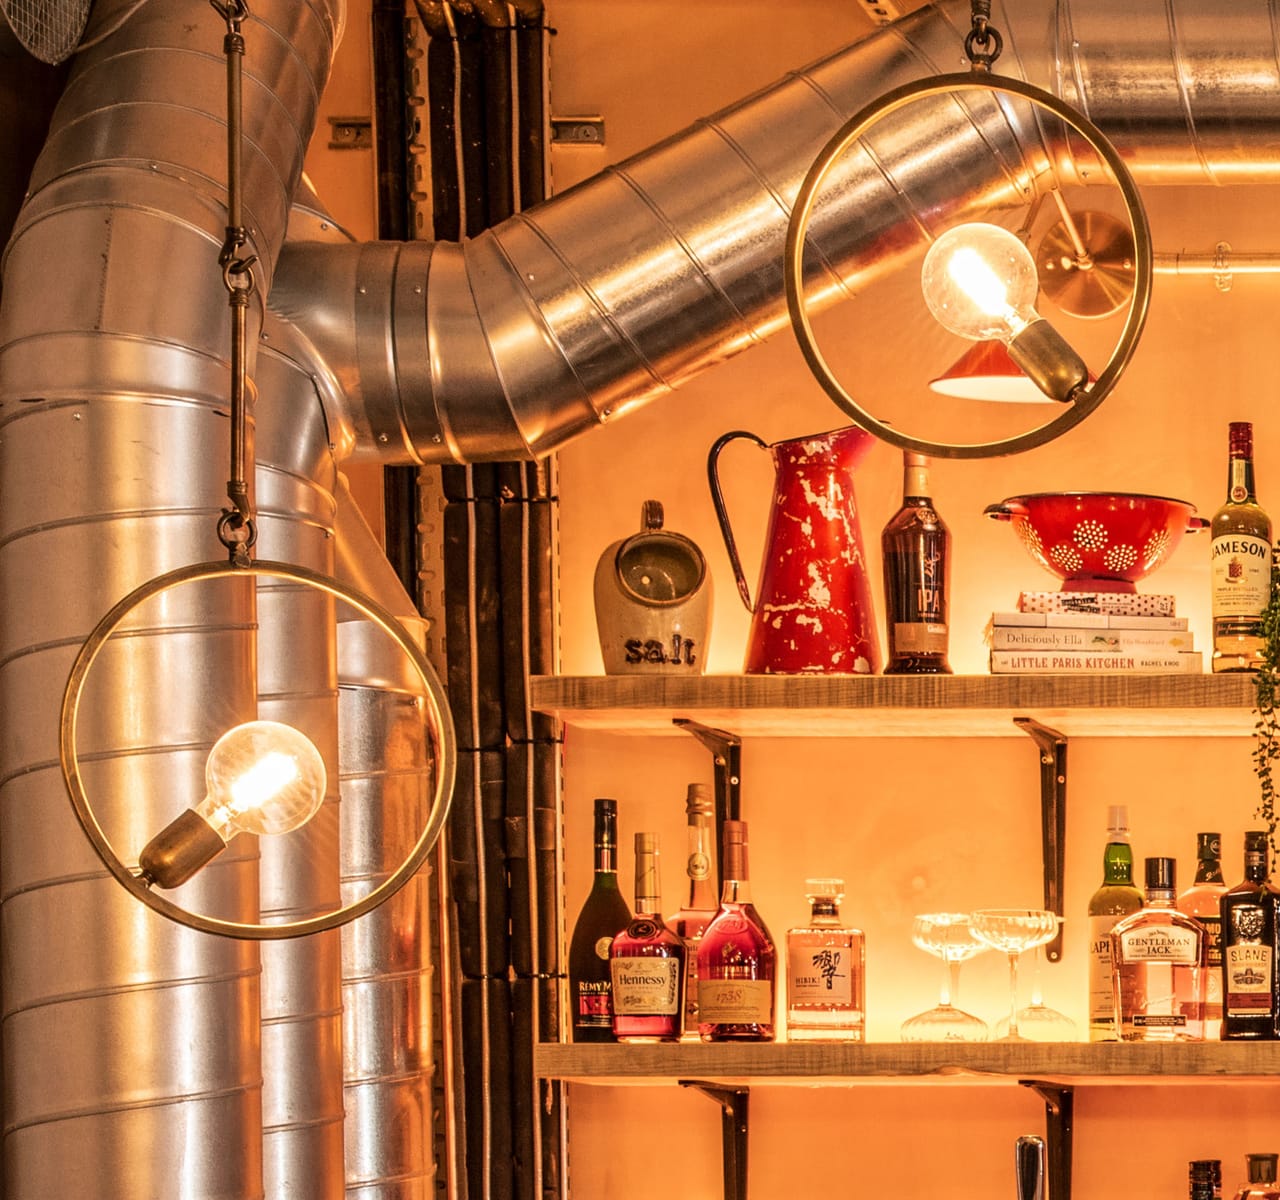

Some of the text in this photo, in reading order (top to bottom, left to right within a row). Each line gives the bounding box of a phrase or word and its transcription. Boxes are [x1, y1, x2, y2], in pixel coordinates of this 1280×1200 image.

[1211, 541, 1267, 560] JAMESON
[918, 587, 940, 612] IPA
[1006, 633, 1083, 646] Deliciously Ella
[625, 633, 697, 666] salt
[1011, 657, 1048, 669] LITTLE
[1052, 657, 1082, 669] PARIS
[1085, 658, 1135, 669] KITCHEN
[1127, 937, 1191, 946] GENTLEMAN
[1146, 945, 1172, 955] JACK
[1230, 949, 1268, 962] SLANE
[619, 974, 667, 986] Hennessy
